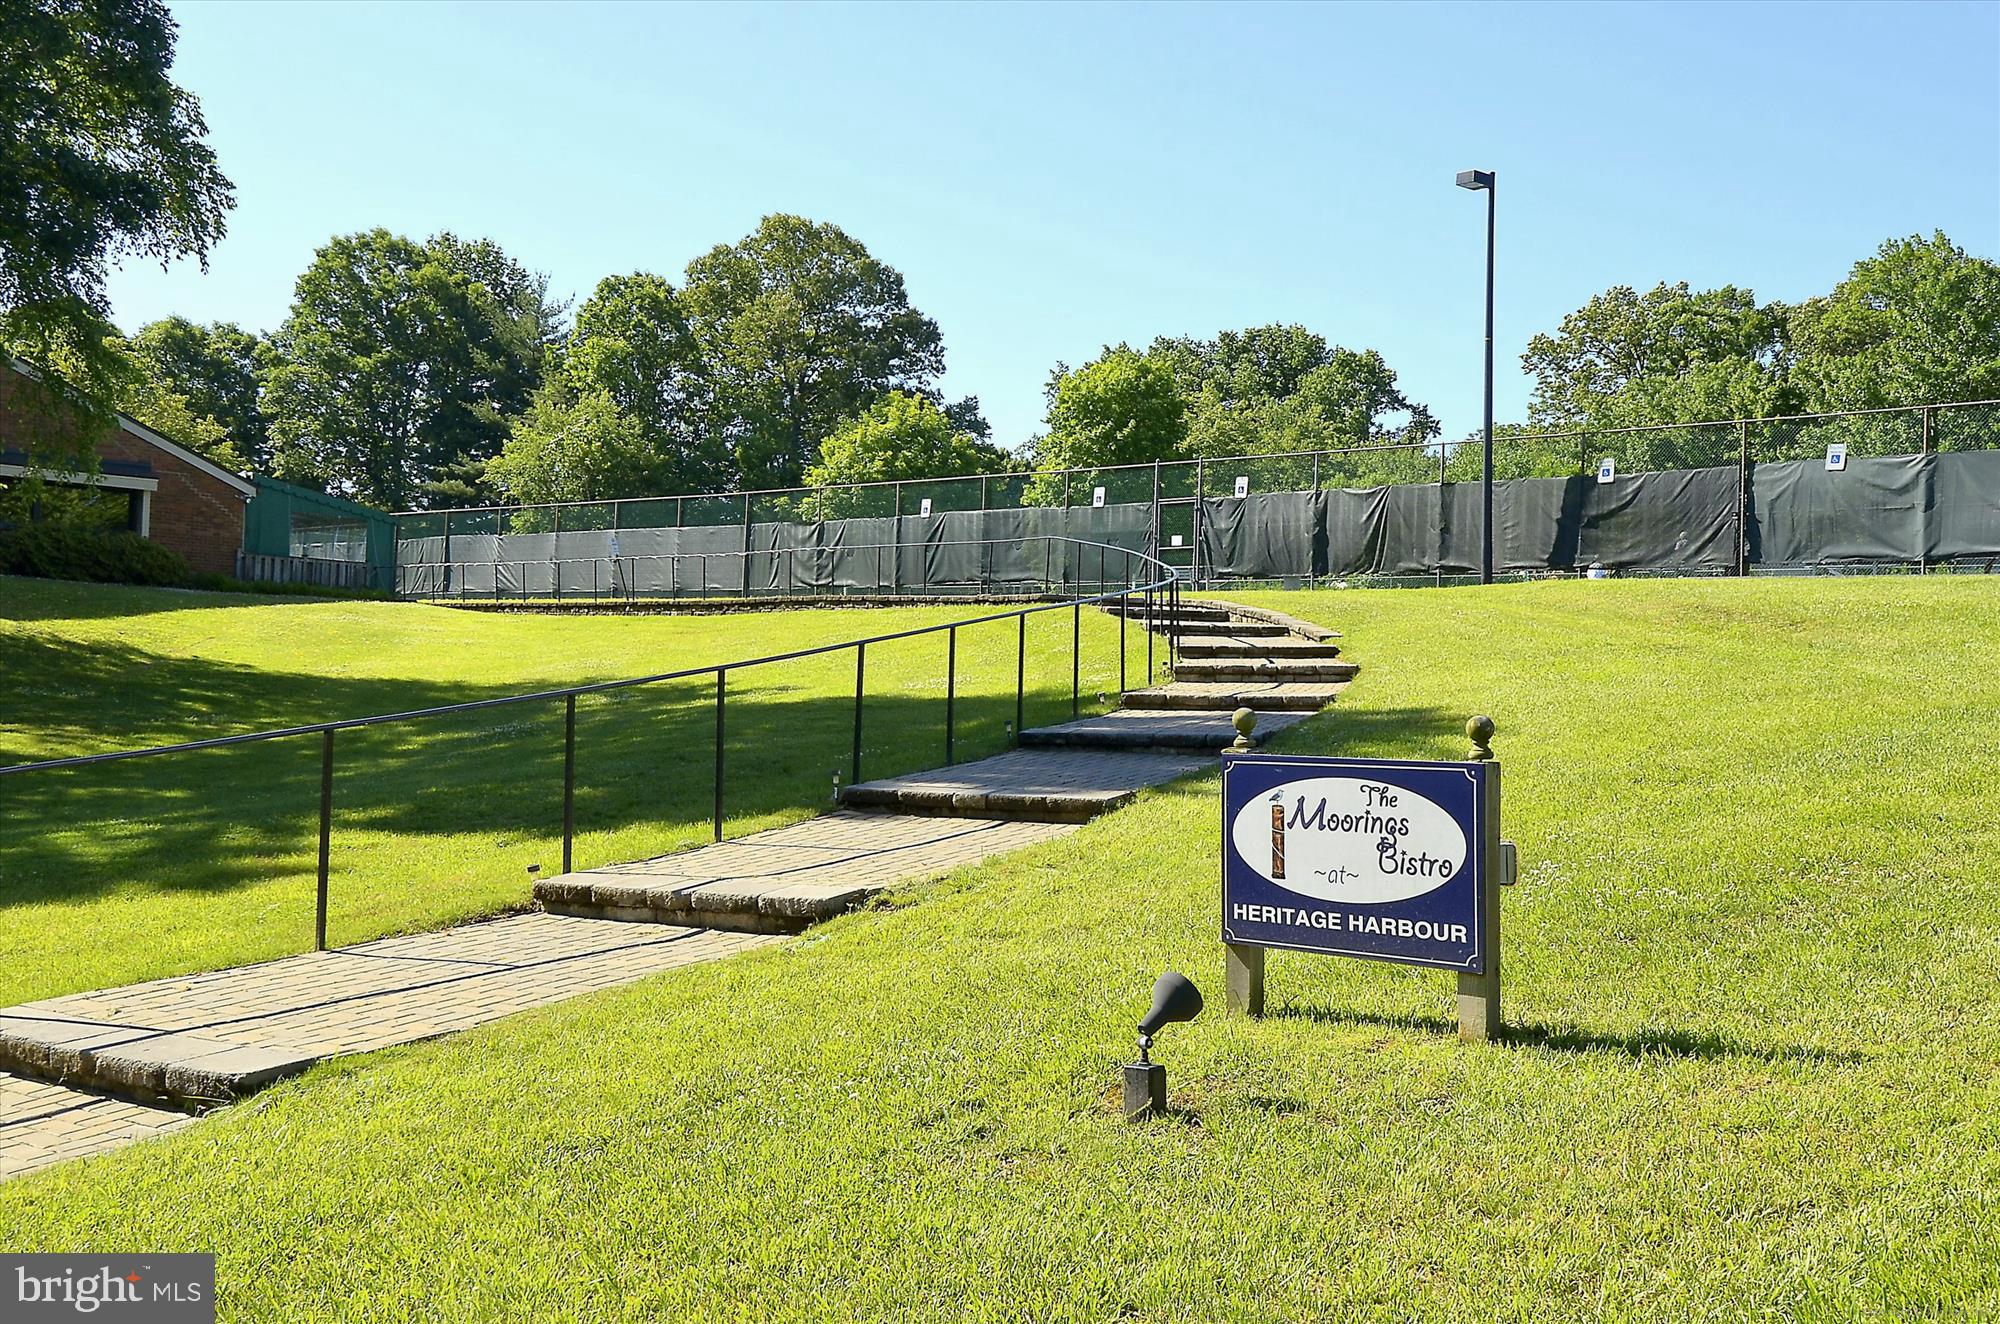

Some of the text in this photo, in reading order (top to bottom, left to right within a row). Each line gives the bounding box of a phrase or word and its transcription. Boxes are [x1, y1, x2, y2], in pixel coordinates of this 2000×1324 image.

[1360, 784, 1398, 808] The
[1287, 795, 1410, 850] Moorings
[1376, 836, 1453, 879] Bistro
[1232, 903, 1468, 944] HERITAGE HARBOUR
